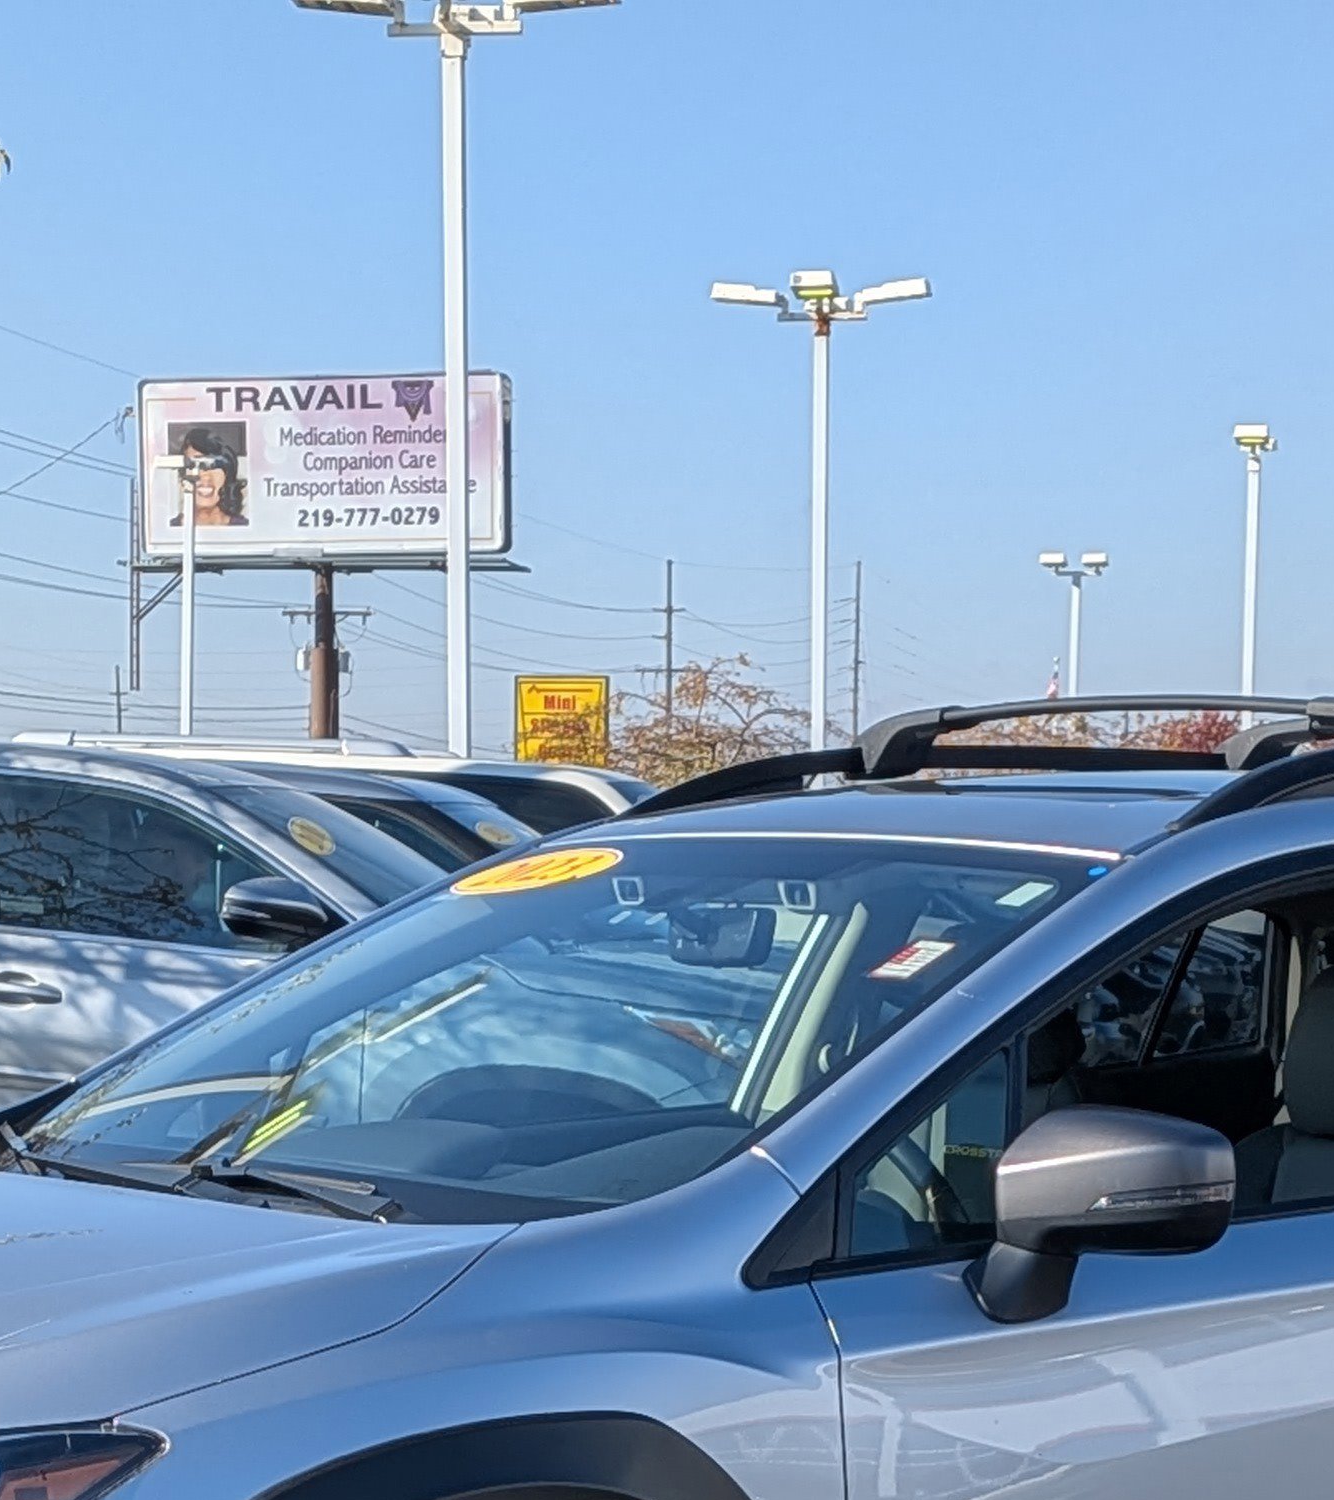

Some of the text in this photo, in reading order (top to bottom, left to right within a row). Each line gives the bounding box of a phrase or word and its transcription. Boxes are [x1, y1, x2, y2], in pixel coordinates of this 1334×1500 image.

[206, 383, 383, 412] TRAVAIL
[279, 426, 368, 446] Medication
[302, 449, 437, 475] Companion Care
[263, 474, 477, 501] Transportation Assistae
[298, 506, 440, 527] 219-777-0279
[543, 694, 577, 711] Mini
